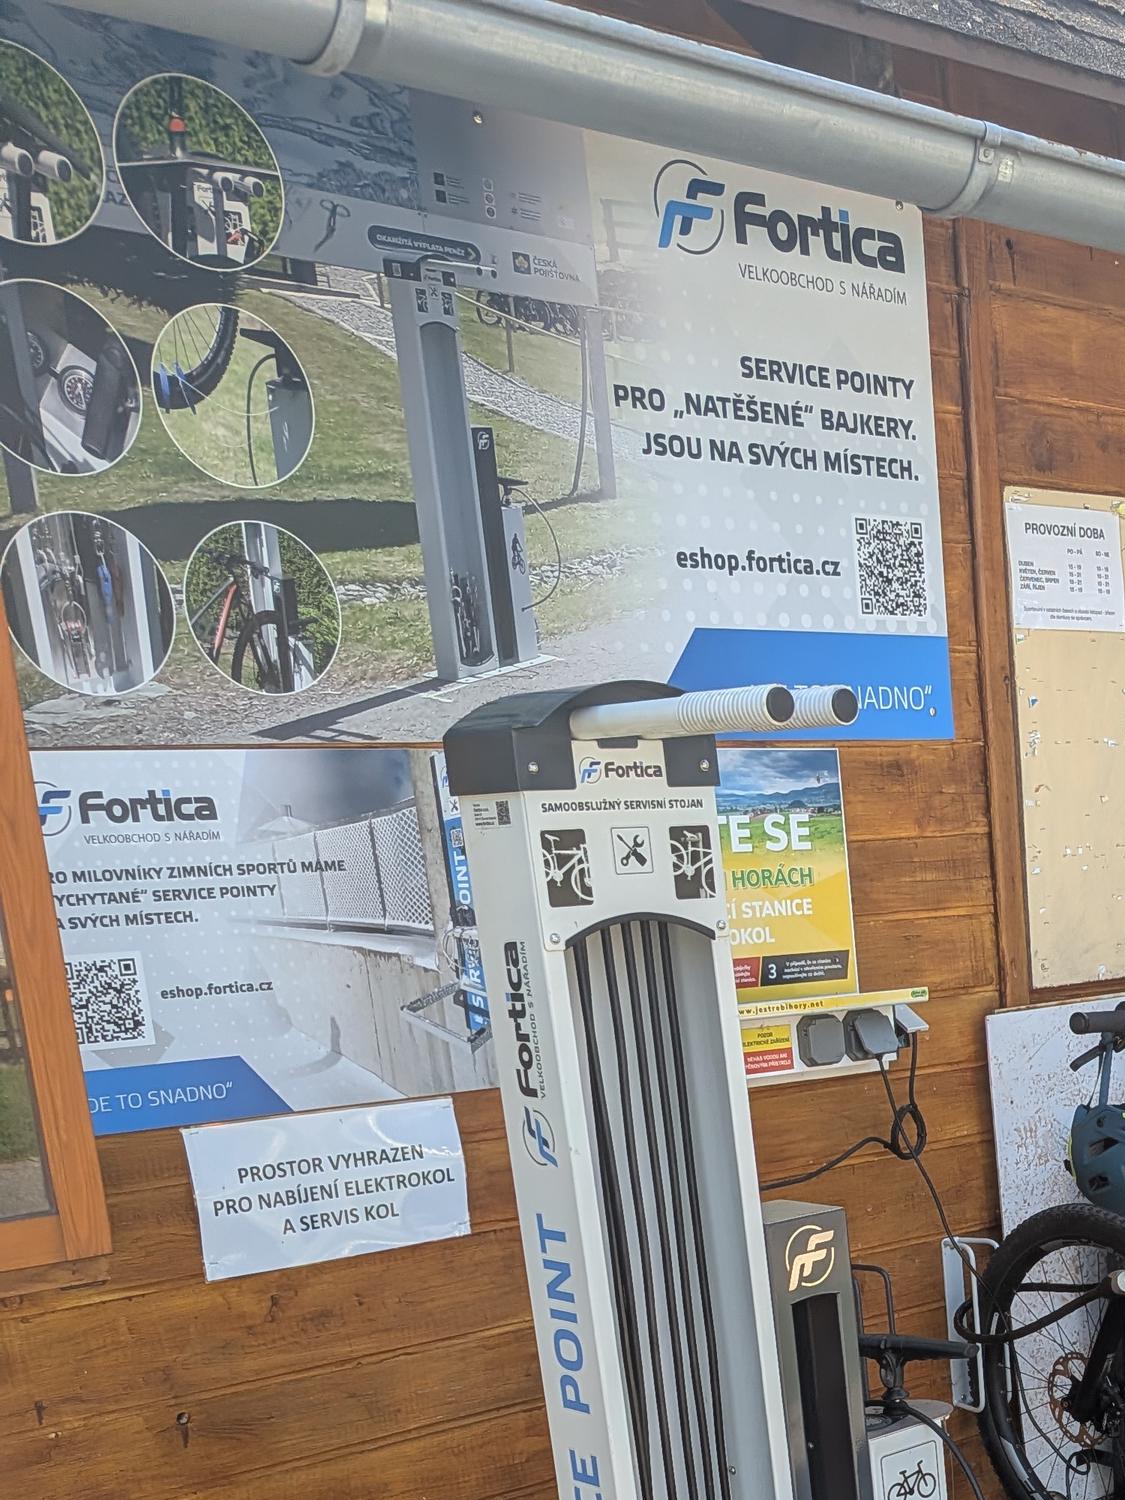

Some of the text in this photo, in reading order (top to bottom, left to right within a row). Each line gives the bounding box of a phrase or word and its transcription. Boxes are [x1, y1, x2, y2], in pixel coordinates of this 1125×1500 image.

[734, 191, 906, 274] Fortica
[738, 263, 908, 306] VELKOOBCHOD S NÁŘADÍM
[739, 355, 916, 400] SERVICE POINTY
[613, 384, 666, 412] PRO
[820, 408, 918, 441] BAJKERY.
[642, 432, 920, 482] JSOU NA SVÝCH MÍSTECH.
[1024, 522, 1106, 540] PROVOZNÍ DOBA
[676, 547, 842, 577] eshop.fortica.cz
[604, 761, 663, 778] Fortica
[78, 789, 218, 825] Fortica
[541, 797, 703, 813] SAMOOBSLUŽNÝ SERVISNÍ STOJAN
[84, 829, 221, 846] VELKOOBCHOD S NÁŘADÍM
[763, 813, 812, 852] SE
[72, 865, 163, 883] MILOVNÍKY
[167, 862, 233, 879] ZIMNÍCH
[237, 858, 297, 876] SPORTŮ
[301, 858, 347, 873] MÁME
[732, 863, 814, 889] HORÁCH
[152, 887, 217, 903] SERVICE
[220, 884, 277, 899] POINTY
[742, 898, 813, 919] STANICE
[68, 912, 121, 929] SVÝCH
[125, 910, 198, 927] MÍSTECH.
[768, 963, 777, 980] 3
[160, 980, 274, 1000] eshop.fortica.cz
[504, 941, 538, 1099] Fortica
[520, 941, 545, 1100] VELKOOBCHOD S NÁŘADÍM
[738, 1001, 824, 1015] ww.jestrebihory.net
[116, 1092, 142, 1109] TO
[237, 1143, 424, 1184] PROSTOR VYHRAZEN
[213, 1167, 455, 1217] PRO NABÍJENÍ ELEKTROKOL
[282, 1202, 400, 1235] A SERVIS KOL
[536, 1212, 591, 1415] POINT
